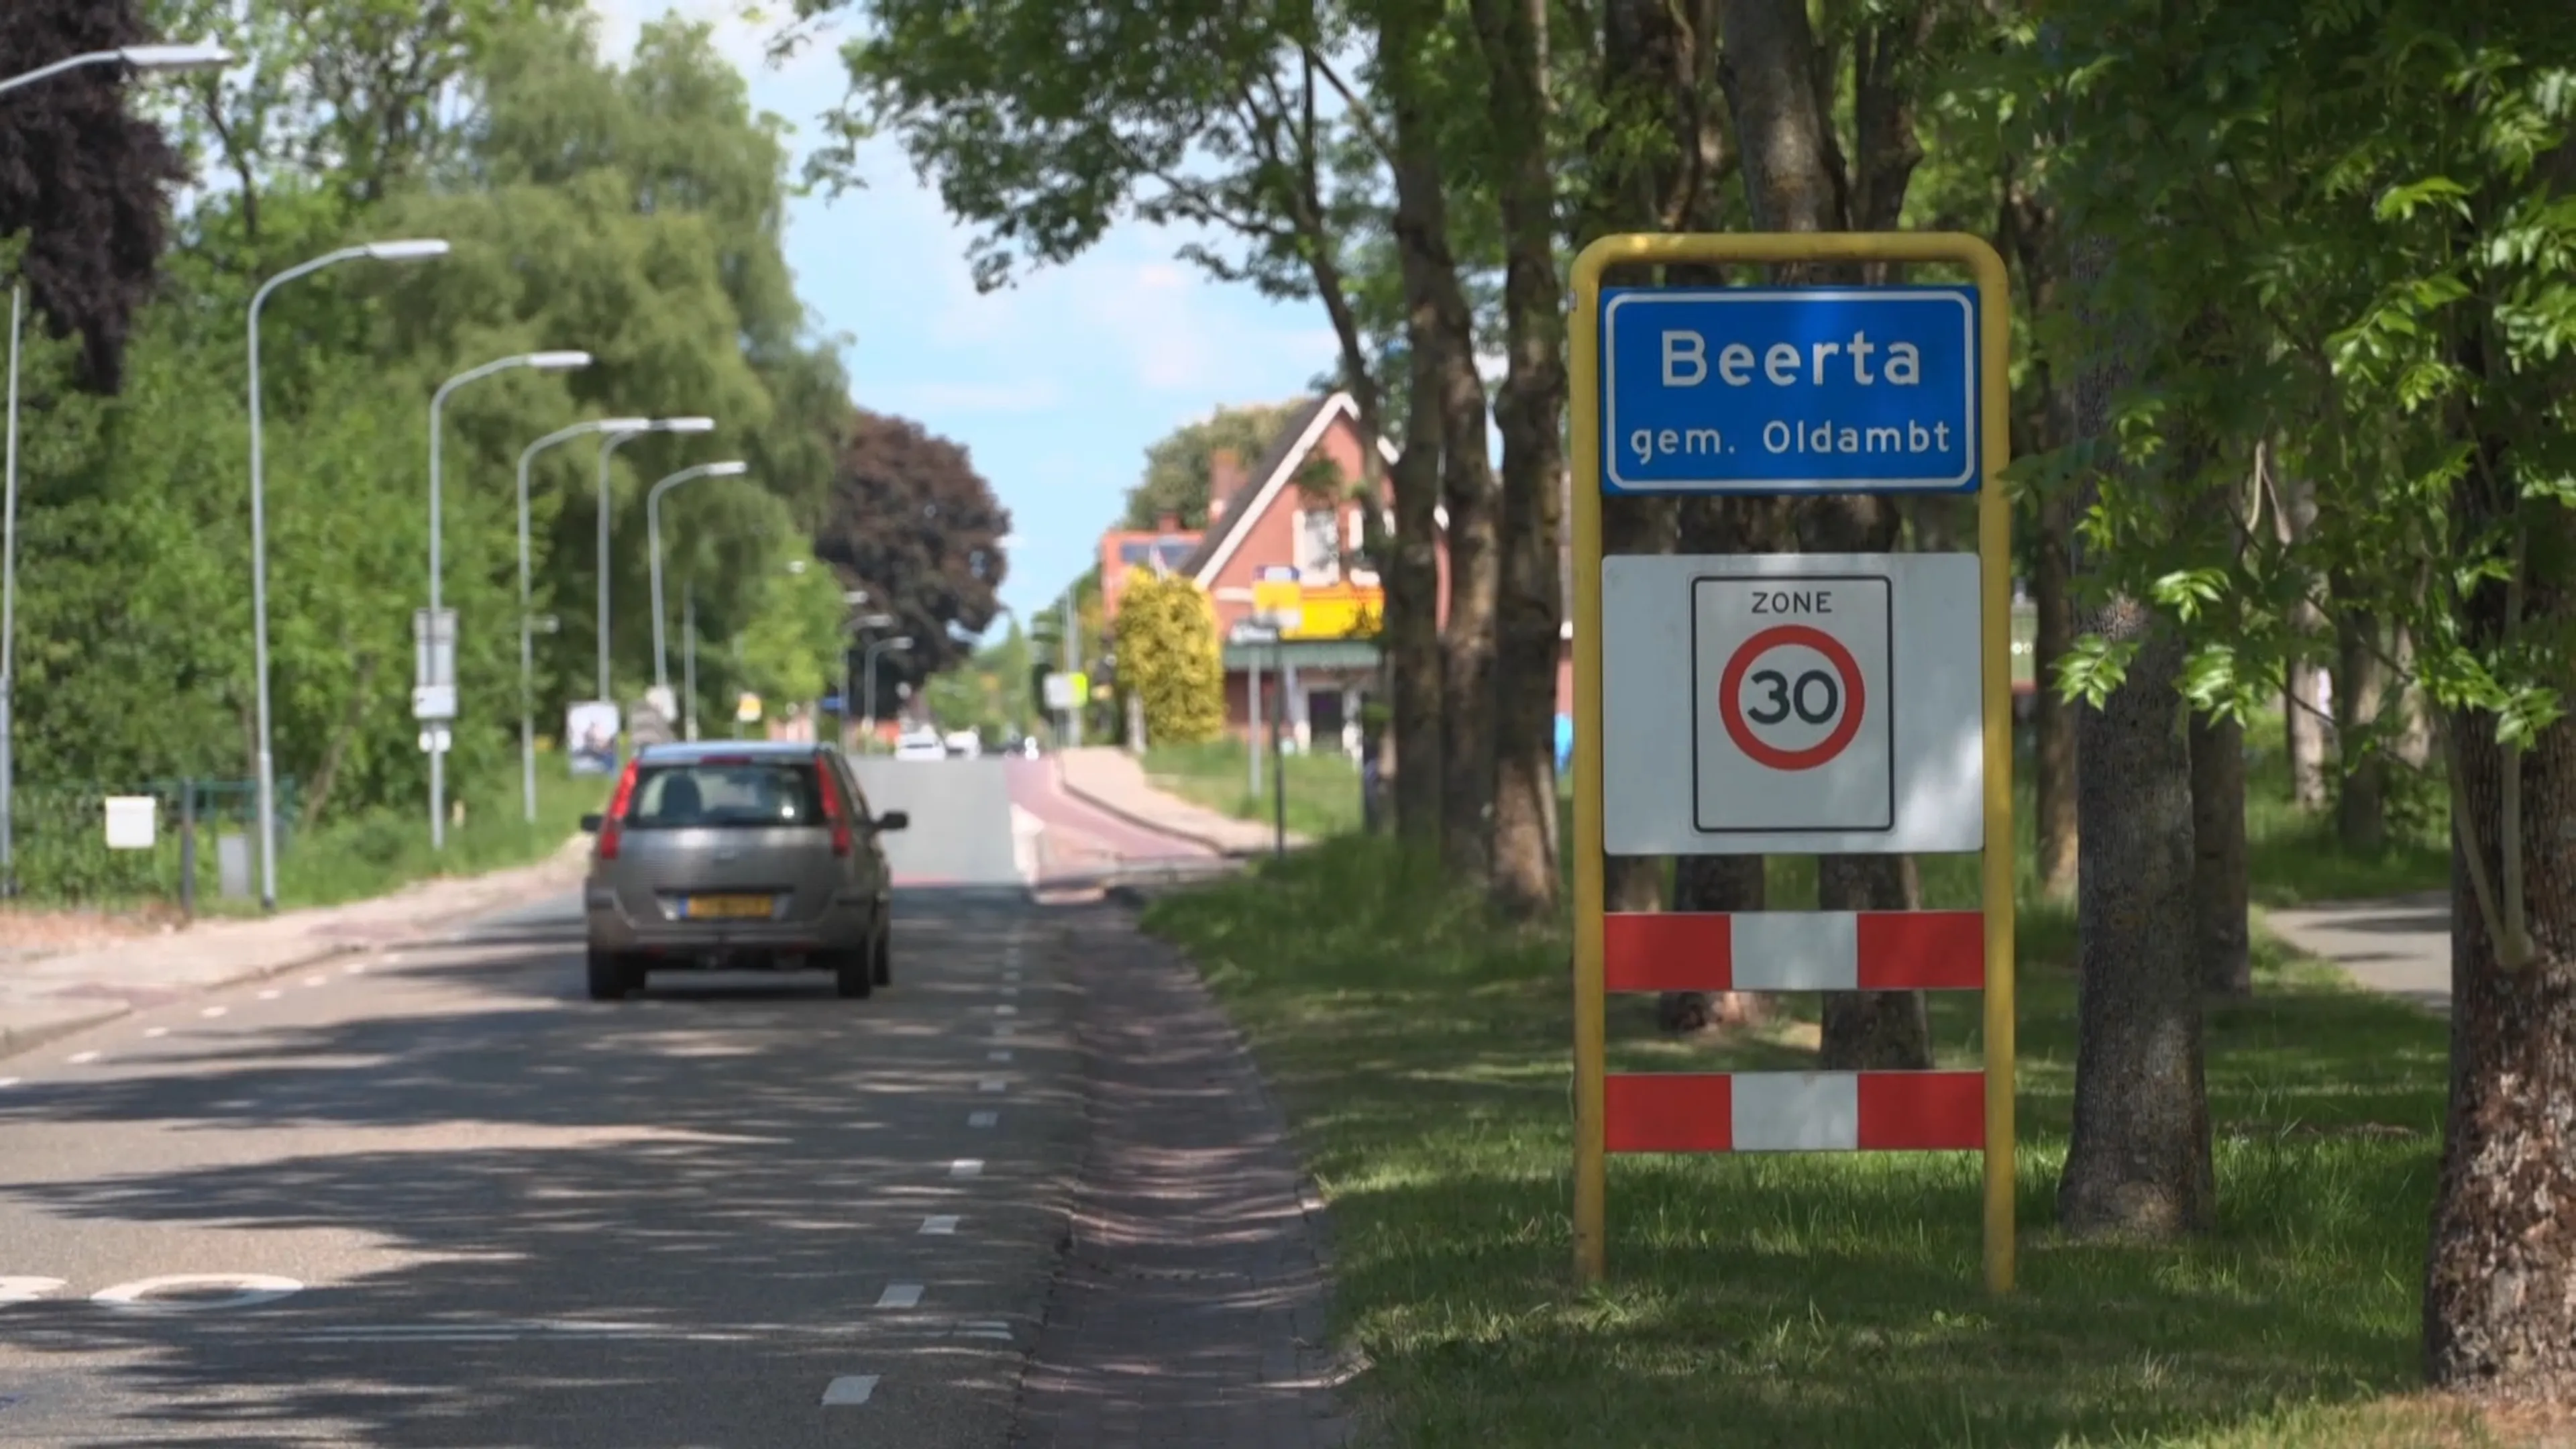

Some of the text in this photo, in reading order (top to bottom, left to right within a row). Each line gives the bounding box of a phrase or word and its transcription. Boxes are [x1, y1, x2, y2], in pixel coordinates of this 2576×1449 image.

[1661, 330, 1921, 386] Beerta
[1630, 420, 1951, 464] gem. Oldambt
[1751, 591, 1833, 614] ZONE
[1747, 669, 1839, 725] 30
